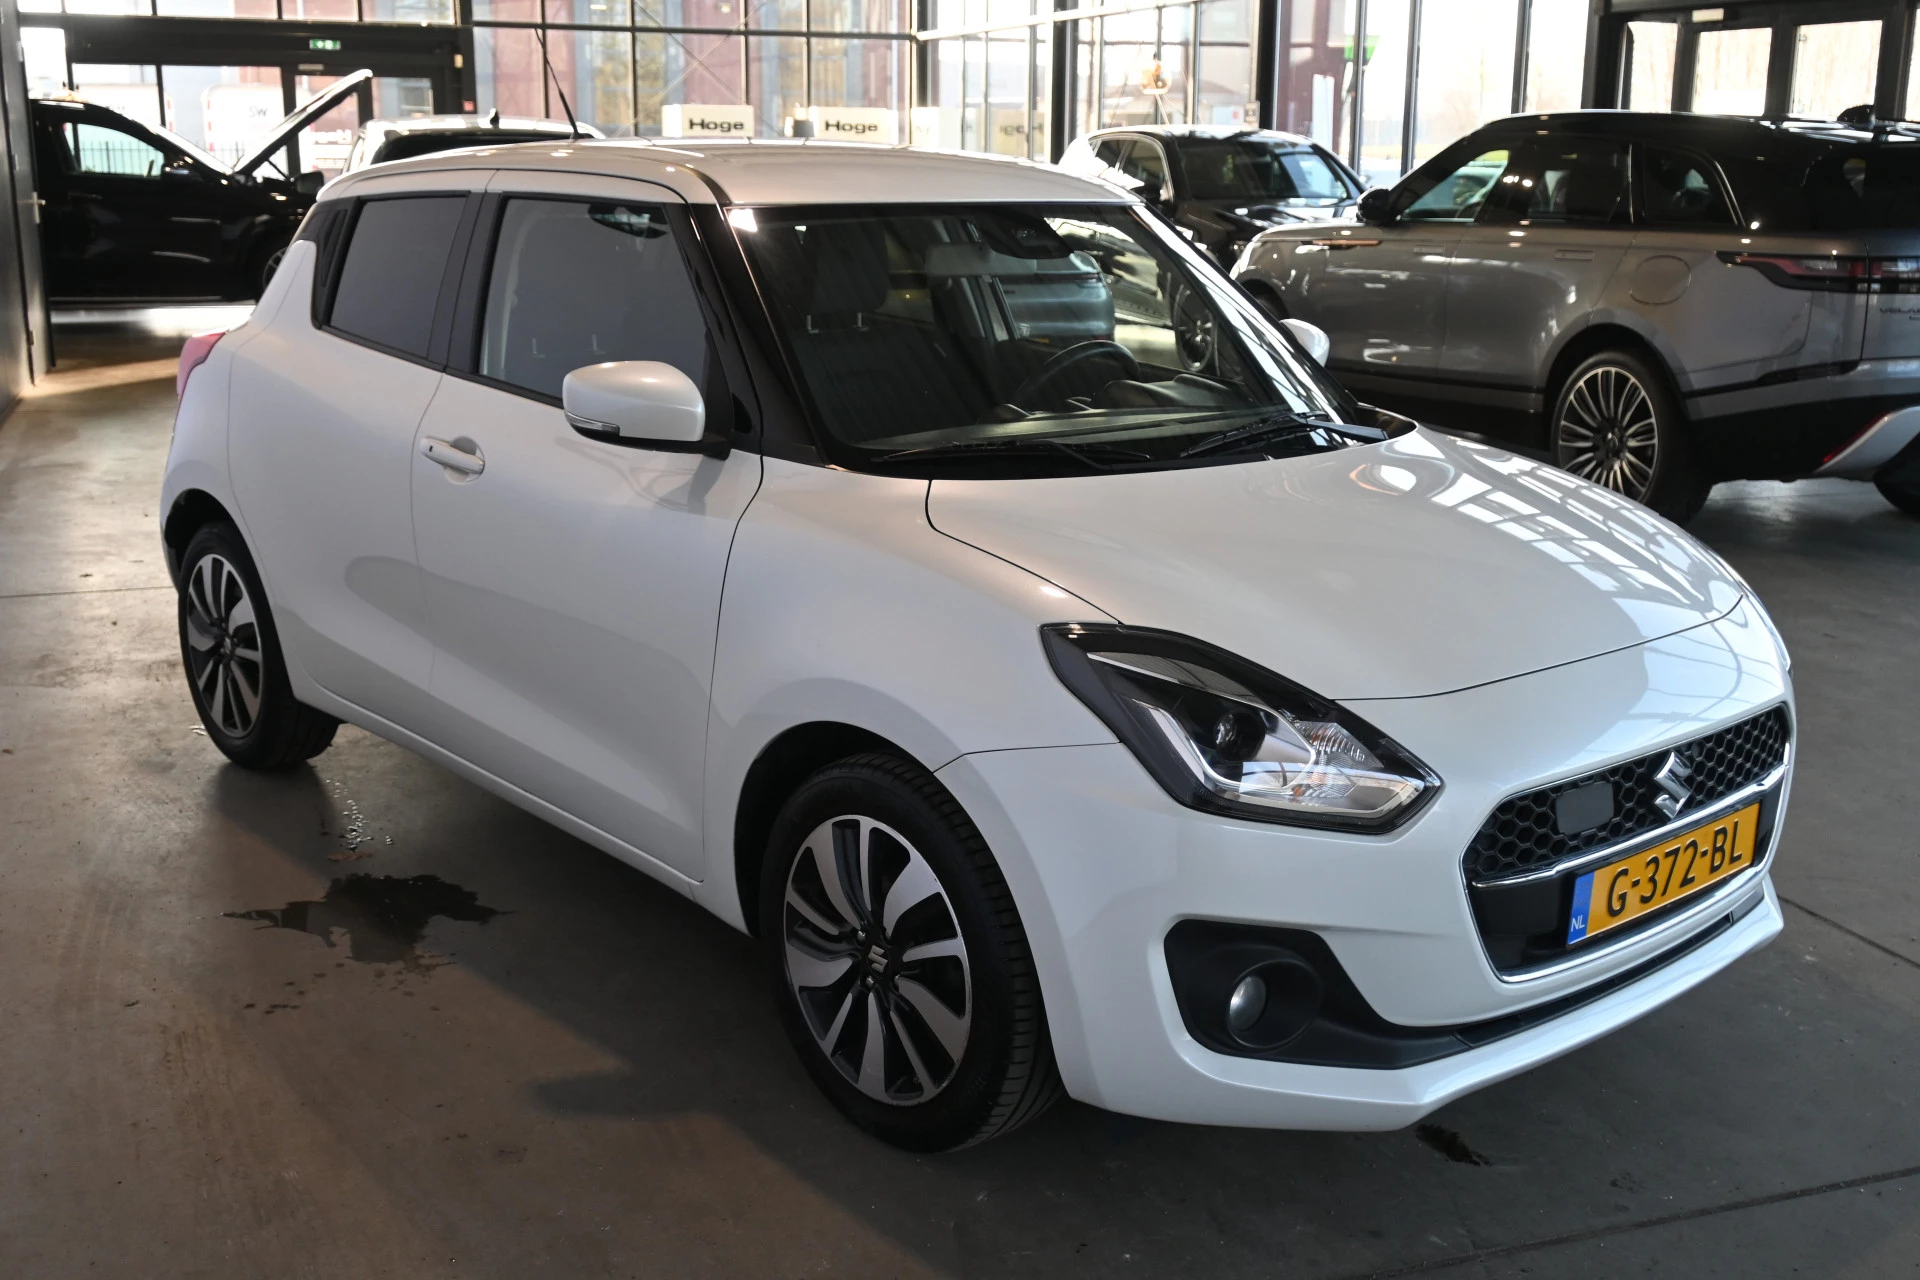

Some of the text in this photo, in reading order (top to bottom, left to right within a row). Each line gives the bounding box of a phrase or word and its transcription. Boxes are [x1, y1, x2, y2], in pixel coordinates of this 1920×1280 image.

[689, 118, 744, 131] Hoge
[825, 120, 878, 133] Hoge
[1607, 819, 1742, 918] G-372-BL
[1571, 914, 1585, 932] NL
